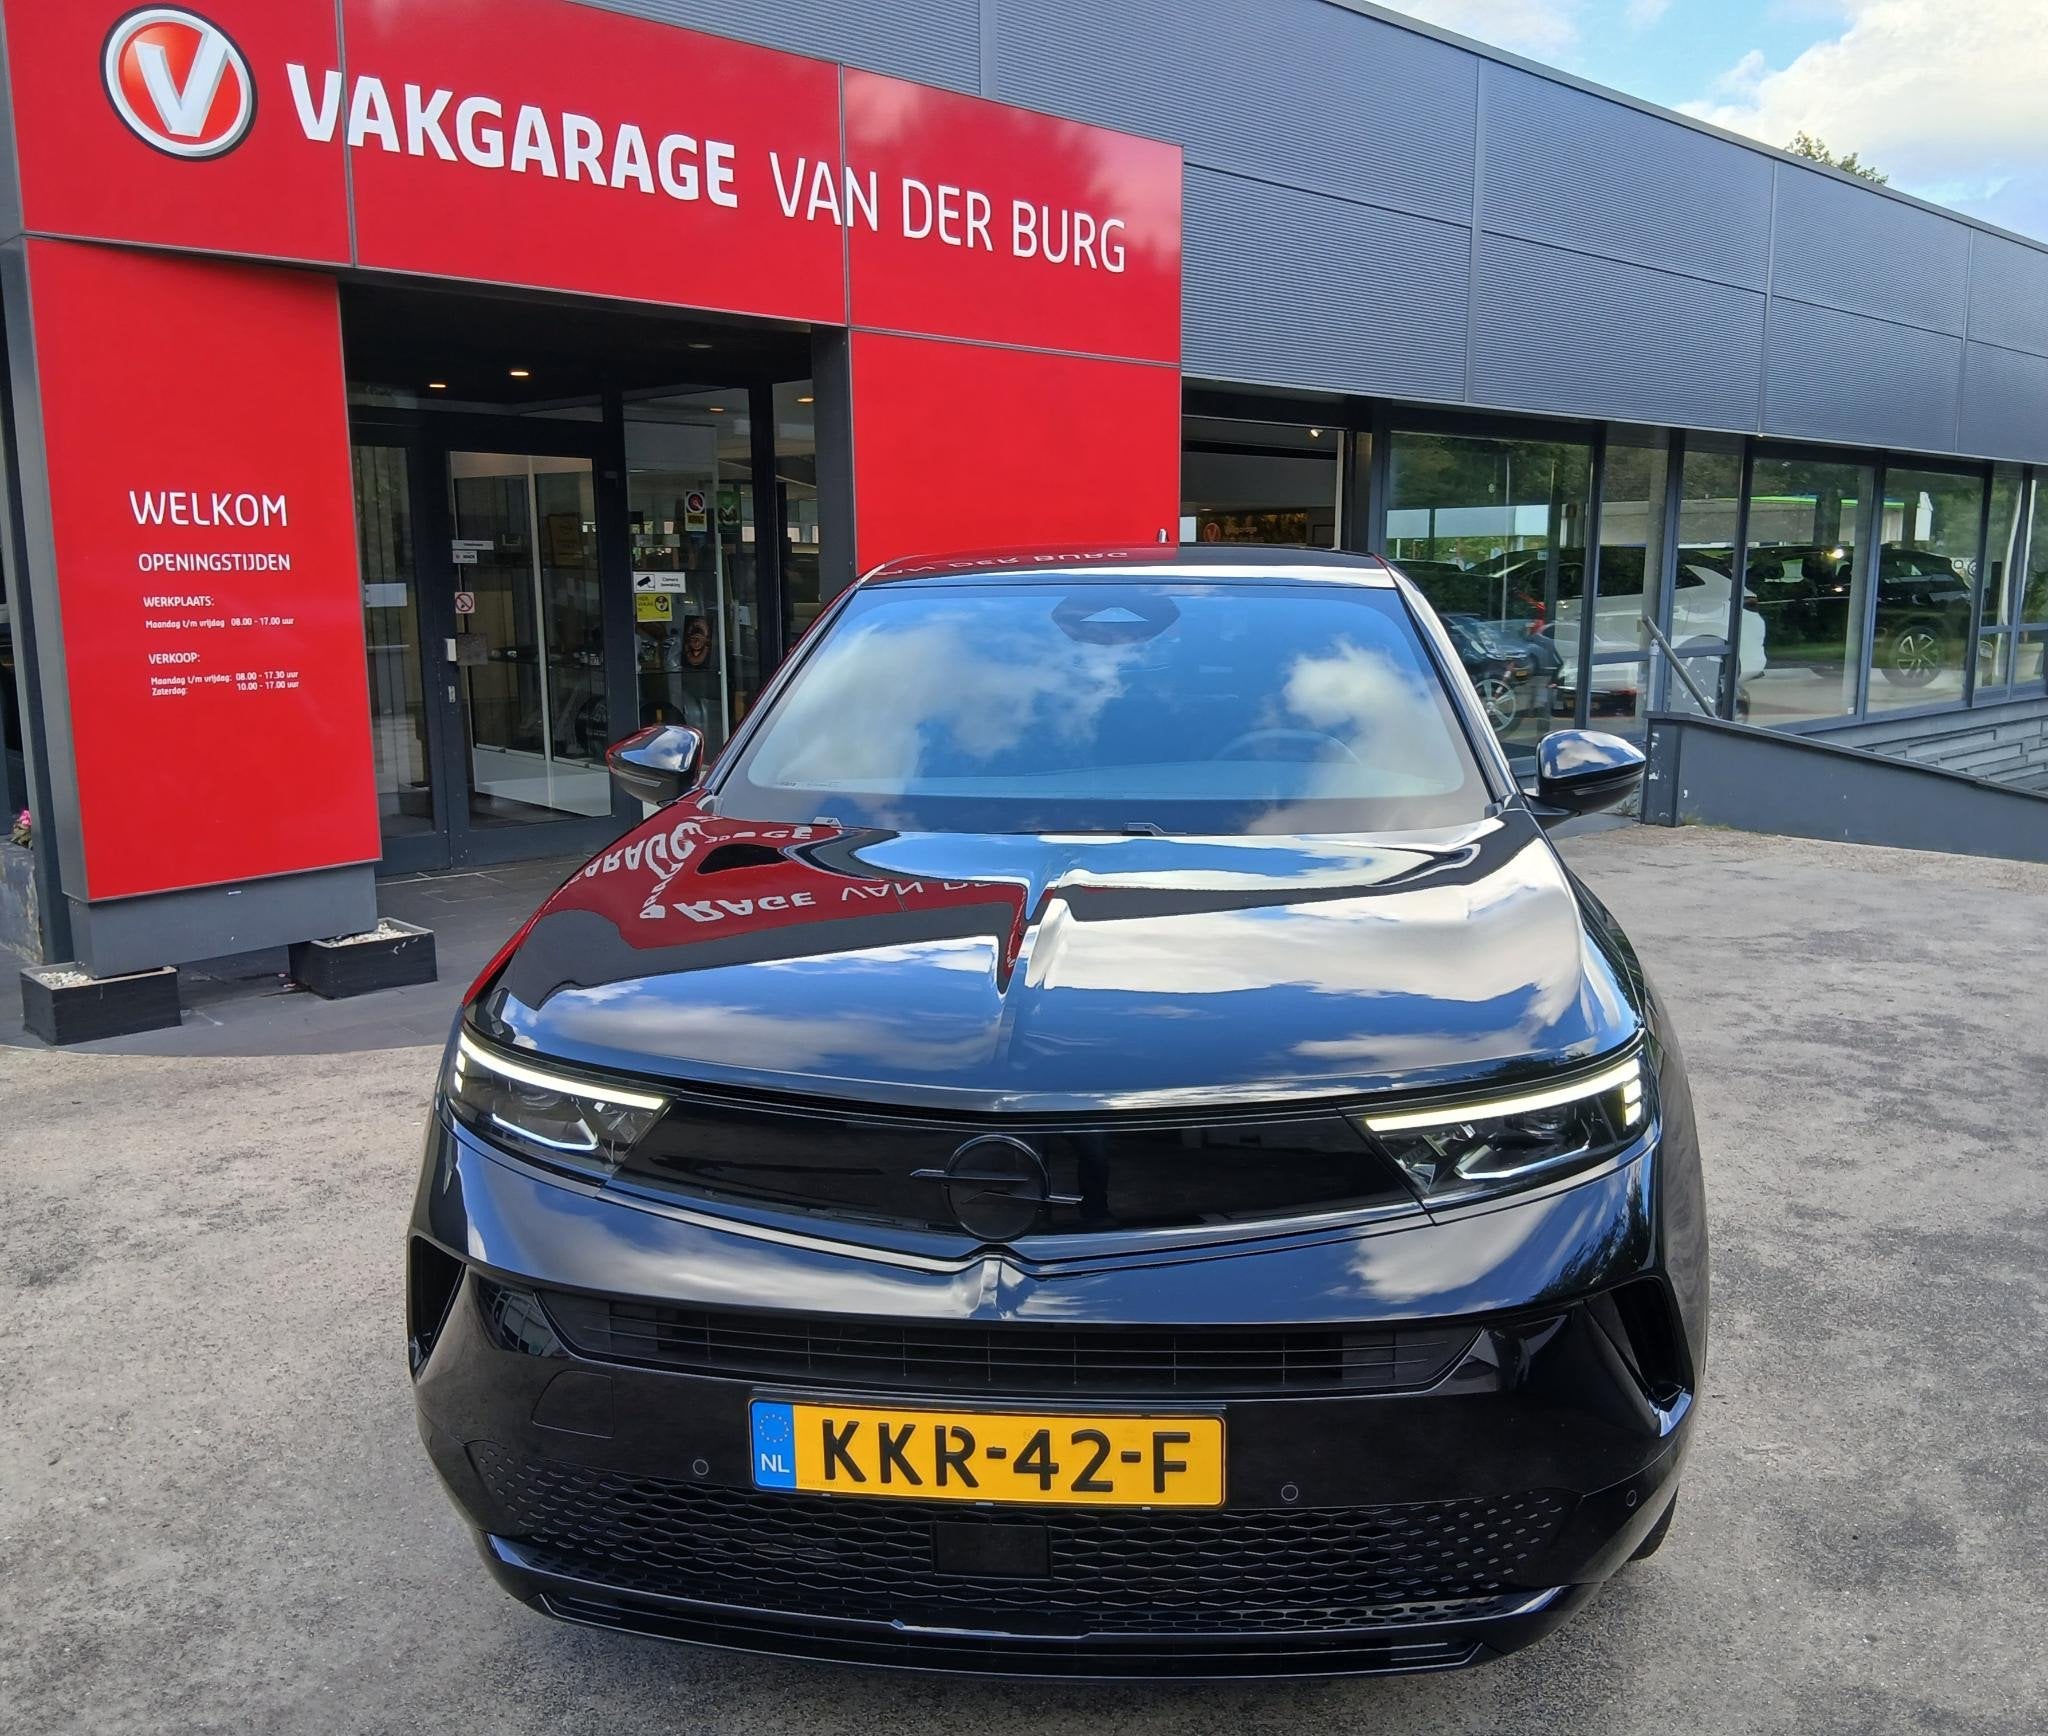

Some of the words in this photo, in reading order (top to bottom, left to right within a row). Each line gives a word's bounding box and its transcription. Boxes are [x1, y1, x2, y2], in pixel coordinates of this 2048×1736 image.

[134, 28, 229, 138] V
[286, 62, 738, 209] VAKGARAGE
[769, 152, 879, 232] VAN
[902, 177, 993, 252] DER
[1012, 200, 1126, 273] BURG
[129, 490, 288, 527] WELKOM
[138, 553, 291, 572] OPENINGSTIJDEN
[143, 596, 215, 608] WERKPLAATS:
[145, 619, 181, 629] Maandag
[182, 619, 198, 628] t/m
[230, 617, 253, 627] 08.00
[260, 616, 281, 626] 17.00
[148, 652, 201, 665] VERKOOP:
[151, 675, 186, 686] Maandag
[187, 674, 203, 684] t/m
[236, 682, 258, 691] 10.00
[264, 680, 286, 689] 17.00
[761, 1453, 790, 1474] NL
[821, 1418, 1191, 1495] KKR-42-F
